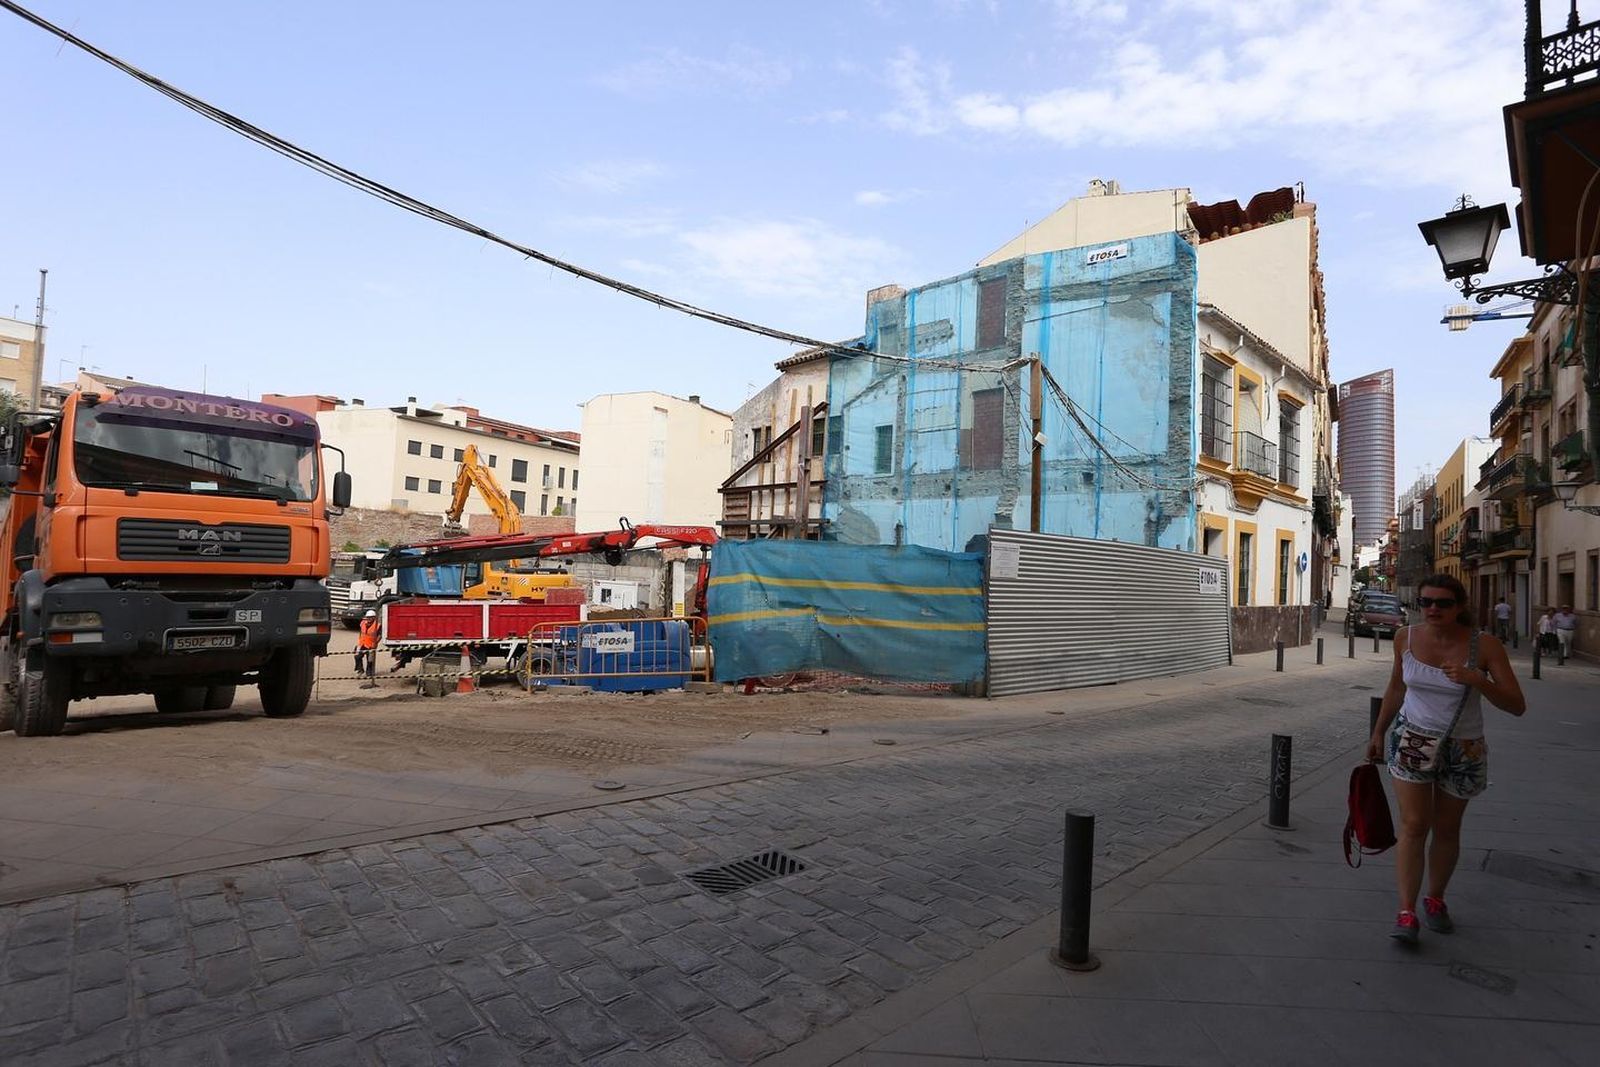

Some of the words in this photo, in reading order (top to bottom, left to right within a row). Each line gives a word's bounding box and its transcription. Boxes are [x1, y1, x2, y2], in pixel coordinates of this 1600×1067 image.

[1089, 249, 1119, 262] ETOSA
[109, 393, 294, 427] MONTERO
[178, 528, 241, 542] MAN
[1200, 571, 1217, 585] ETOSA
[238, 611, 259, 621] SP
[598, 637, 629, 646] ETOSA
